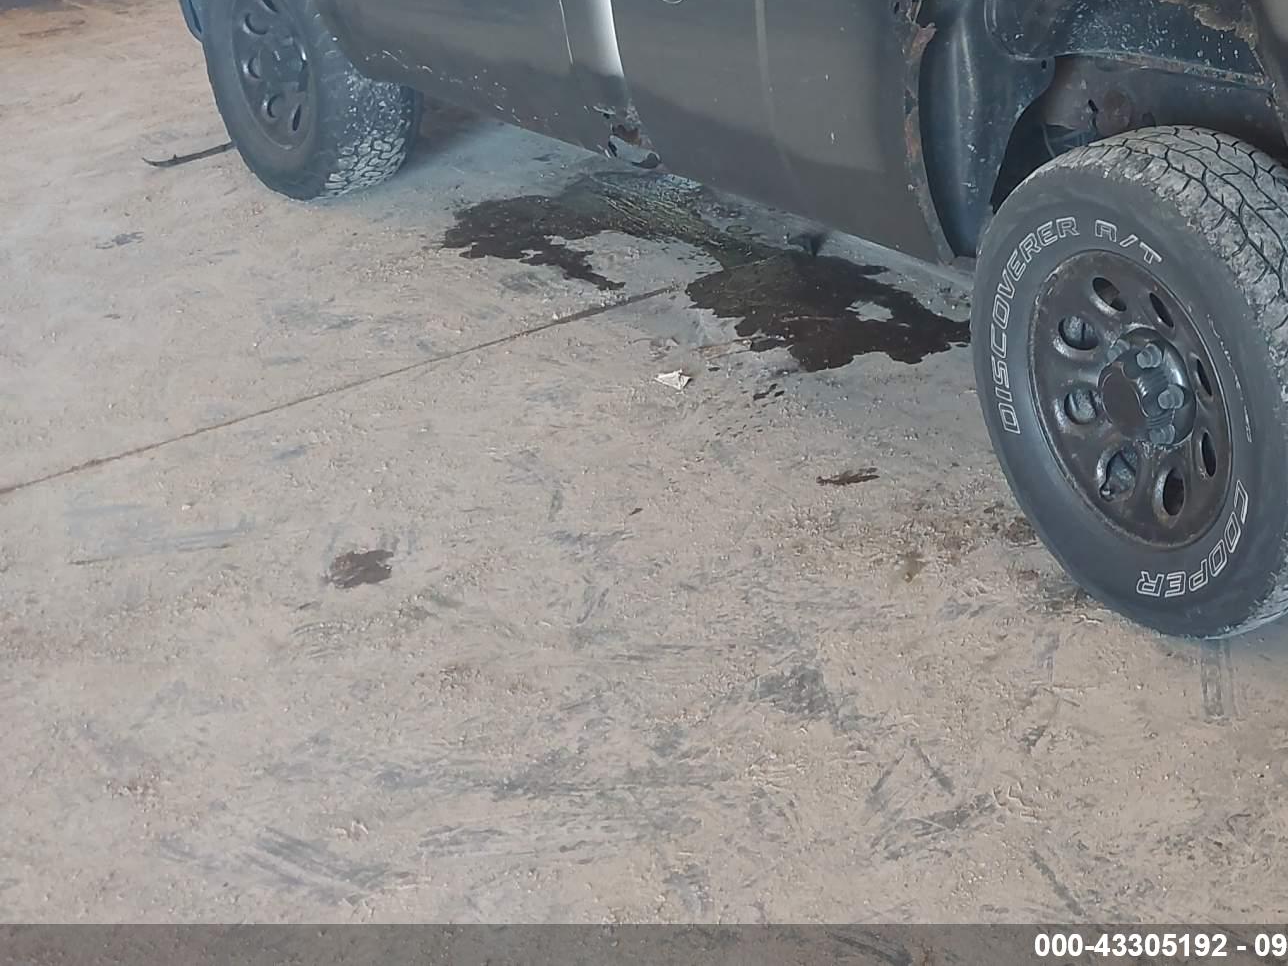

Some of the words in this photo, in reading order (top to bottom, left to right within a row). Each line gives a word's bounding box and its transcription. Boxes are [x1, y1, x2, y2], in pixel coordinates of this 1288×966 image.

[986, 216, 1080, 435] DISCOVERER
[1094, 218, 1164, 265] A/T
[1135, 479, 1250, 598] COOPER
